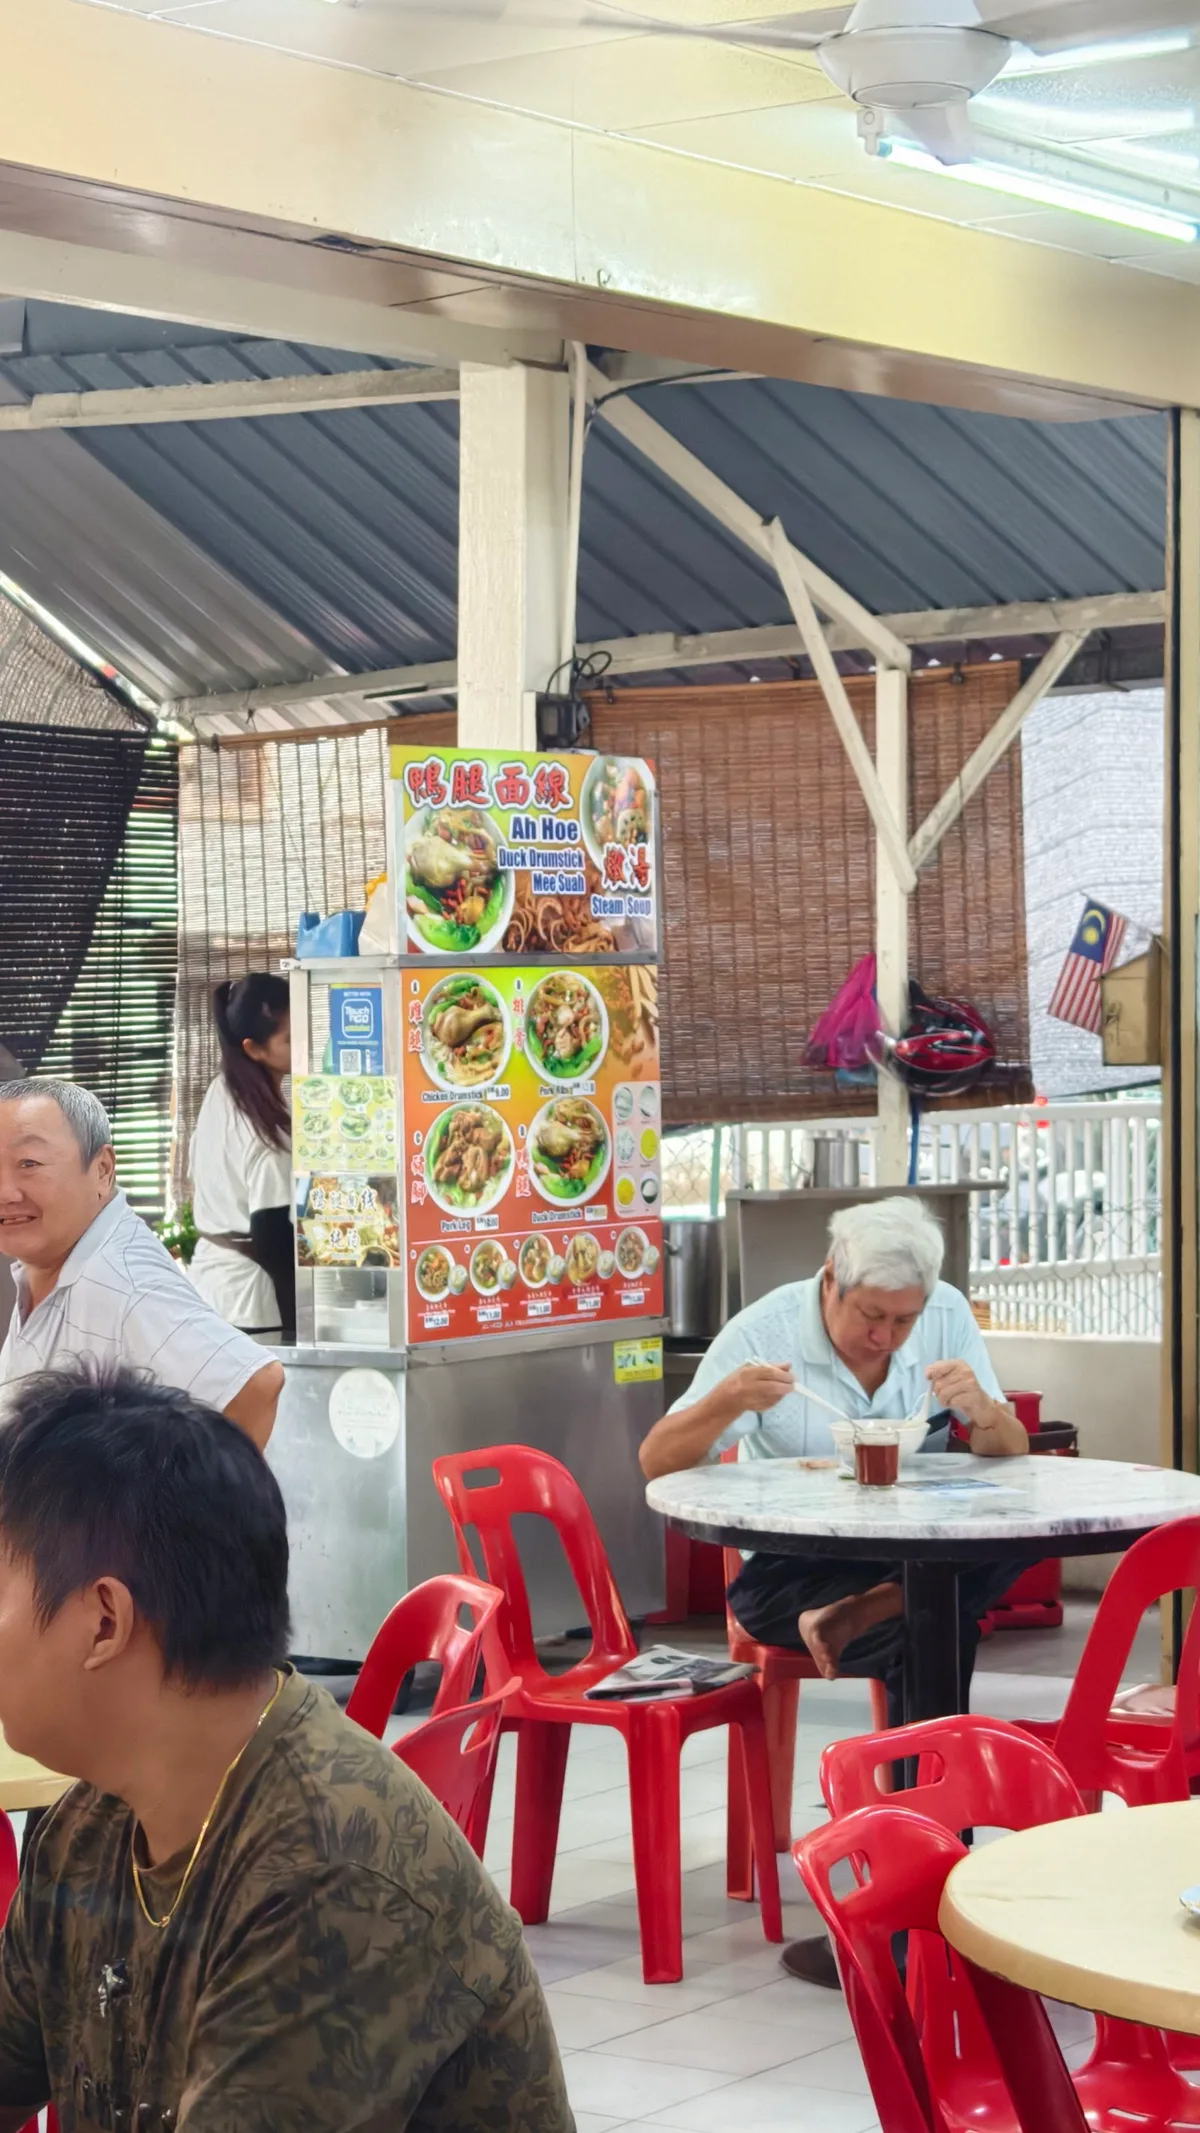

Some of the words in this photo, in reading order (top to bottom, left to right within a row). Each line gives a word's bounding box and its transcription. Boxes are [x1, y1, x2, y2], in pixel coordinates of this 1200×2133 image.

[405, 759, 572, 810] 鴨腿面線
[511, 816, 537, 841] Ah
[541, 817, 579, 841] Hoe
[499, 848, 527, 868] Duck
[528, 848, 584, 869] Drumstick
[533, 874, 556, 892] Mee
[558, 874, 585, 893] Suah
[592, 895, 624, 915] Steam
[626, 895, 651, 916] Soup
[344, 1006, 369, 1016] Touch
[422, 1091, 448, 1102] Chicken
[450, 1090, 482, 1101] Drumstick
[532, 1212, 548, 1223] Duck
[549, 1210, 581, 1221] Drumstick
